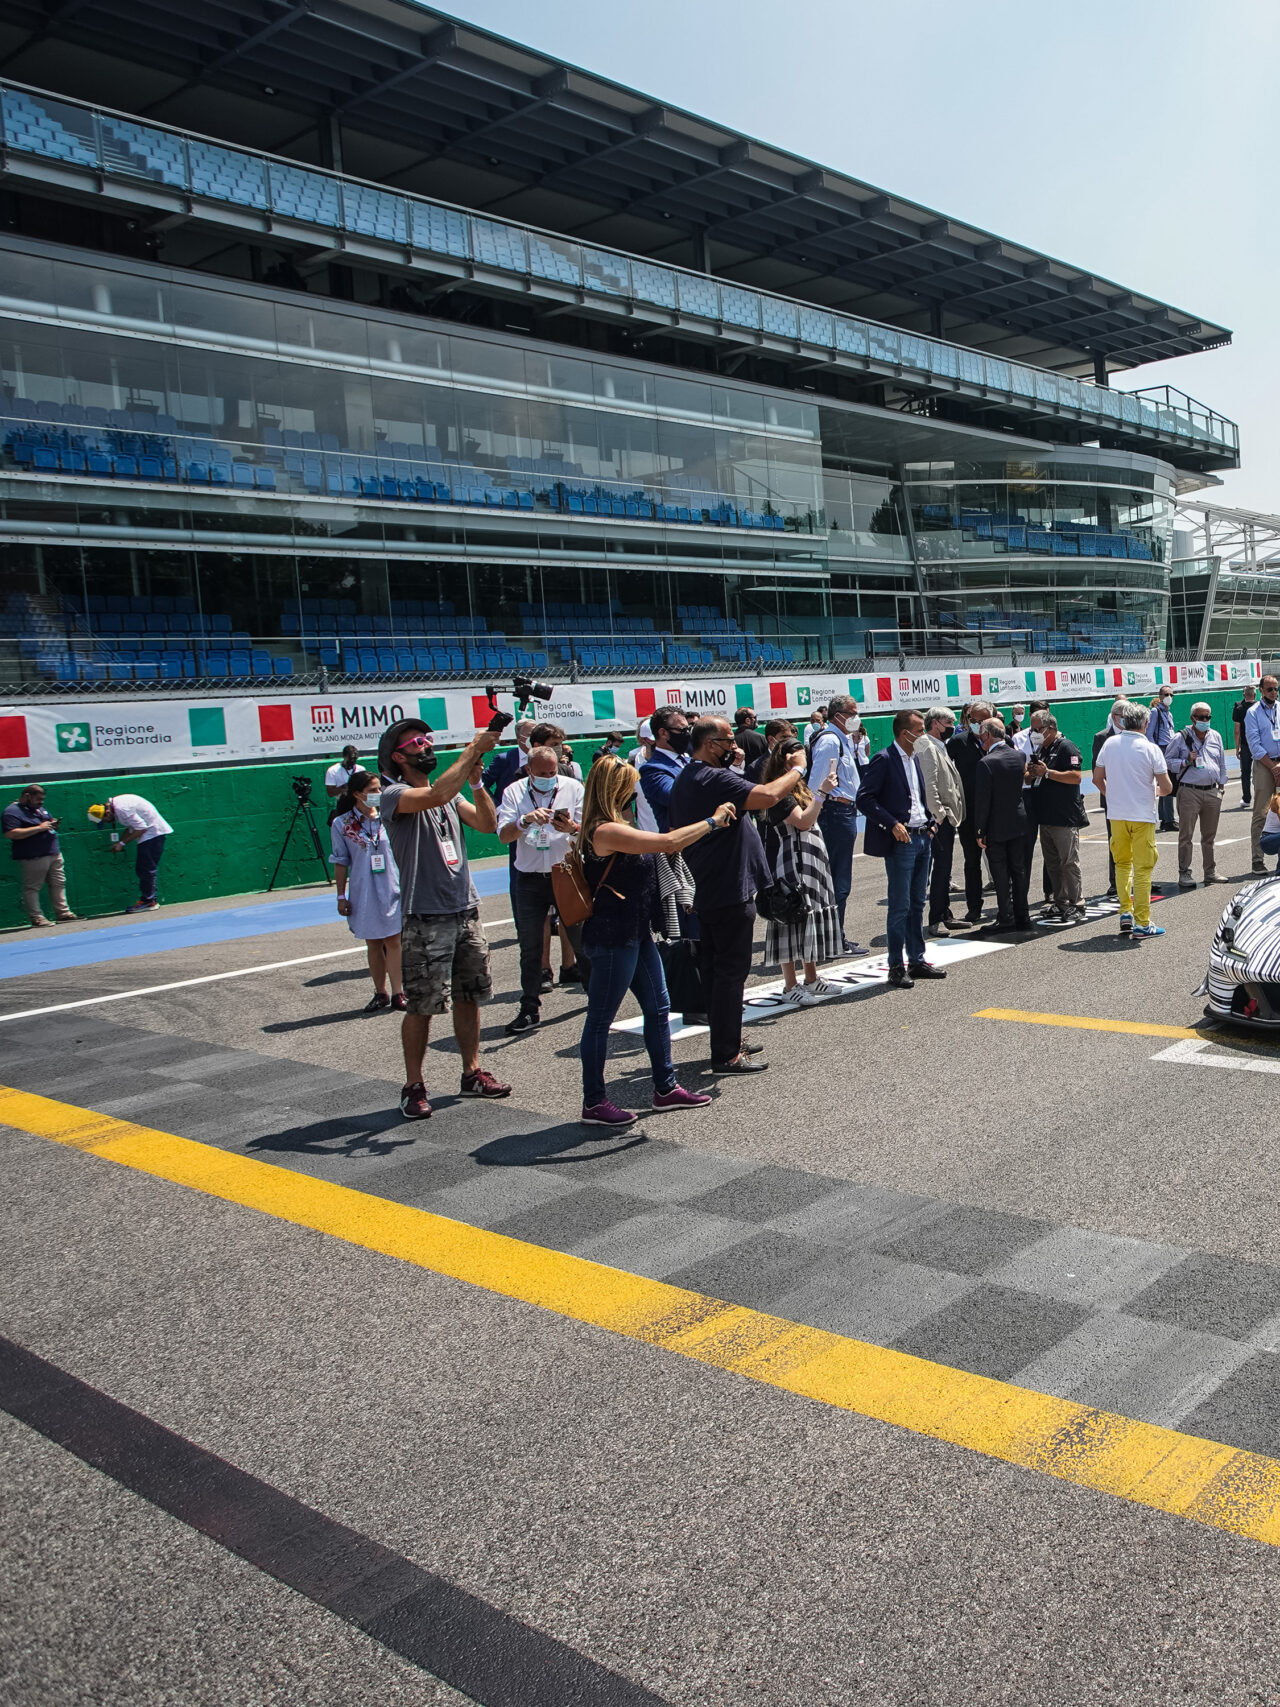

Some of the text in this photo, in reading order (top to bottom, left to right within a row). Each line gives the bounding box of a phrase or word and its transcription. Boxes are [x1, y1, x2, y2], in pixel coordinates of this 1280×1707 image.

[1070, 672, 1092, 684] MIMO
[1188, 667, 1204, 679] MIMO
[811, 688, 835, 696] Regione
[912, 678, 940, 694] MIMO
[686, 689, 726, 707] MIMO
[537, 703, 573, 712] Regione
[341, 704, 404, 728] MIMO
[537, 711, 583, 720] Lombardia
[95, 724, 155, 737] Regione
[96, 733, 172, 747] Lombardia
[313, 734, 339, 743] MILANO
[340, 733, 363, 742] MONZA
